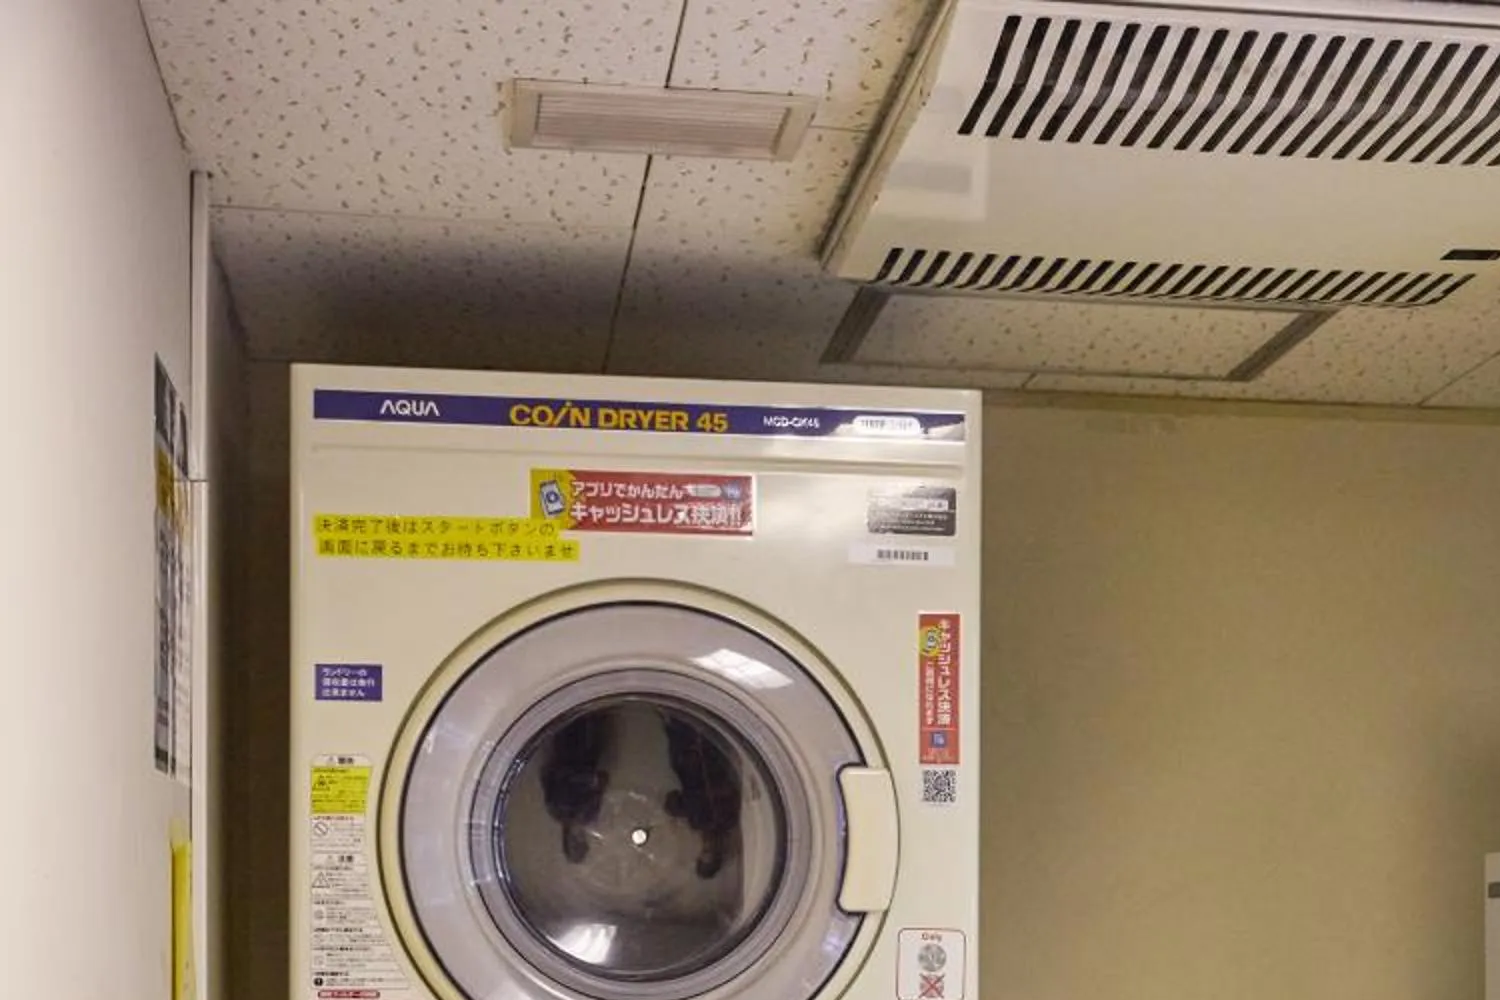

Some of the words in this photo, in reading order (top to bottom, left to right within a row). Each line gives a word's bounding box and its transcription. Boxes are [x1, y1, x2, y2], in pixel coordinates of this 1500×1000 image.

[379, 399, 440, 417] AQUA
[509, 401, 591, 428] COIN
[598, 408, 689, 432] DRYER
[696, 410, 729, 433] 45
[570, 480, 685, 501] アプリでかんたん
